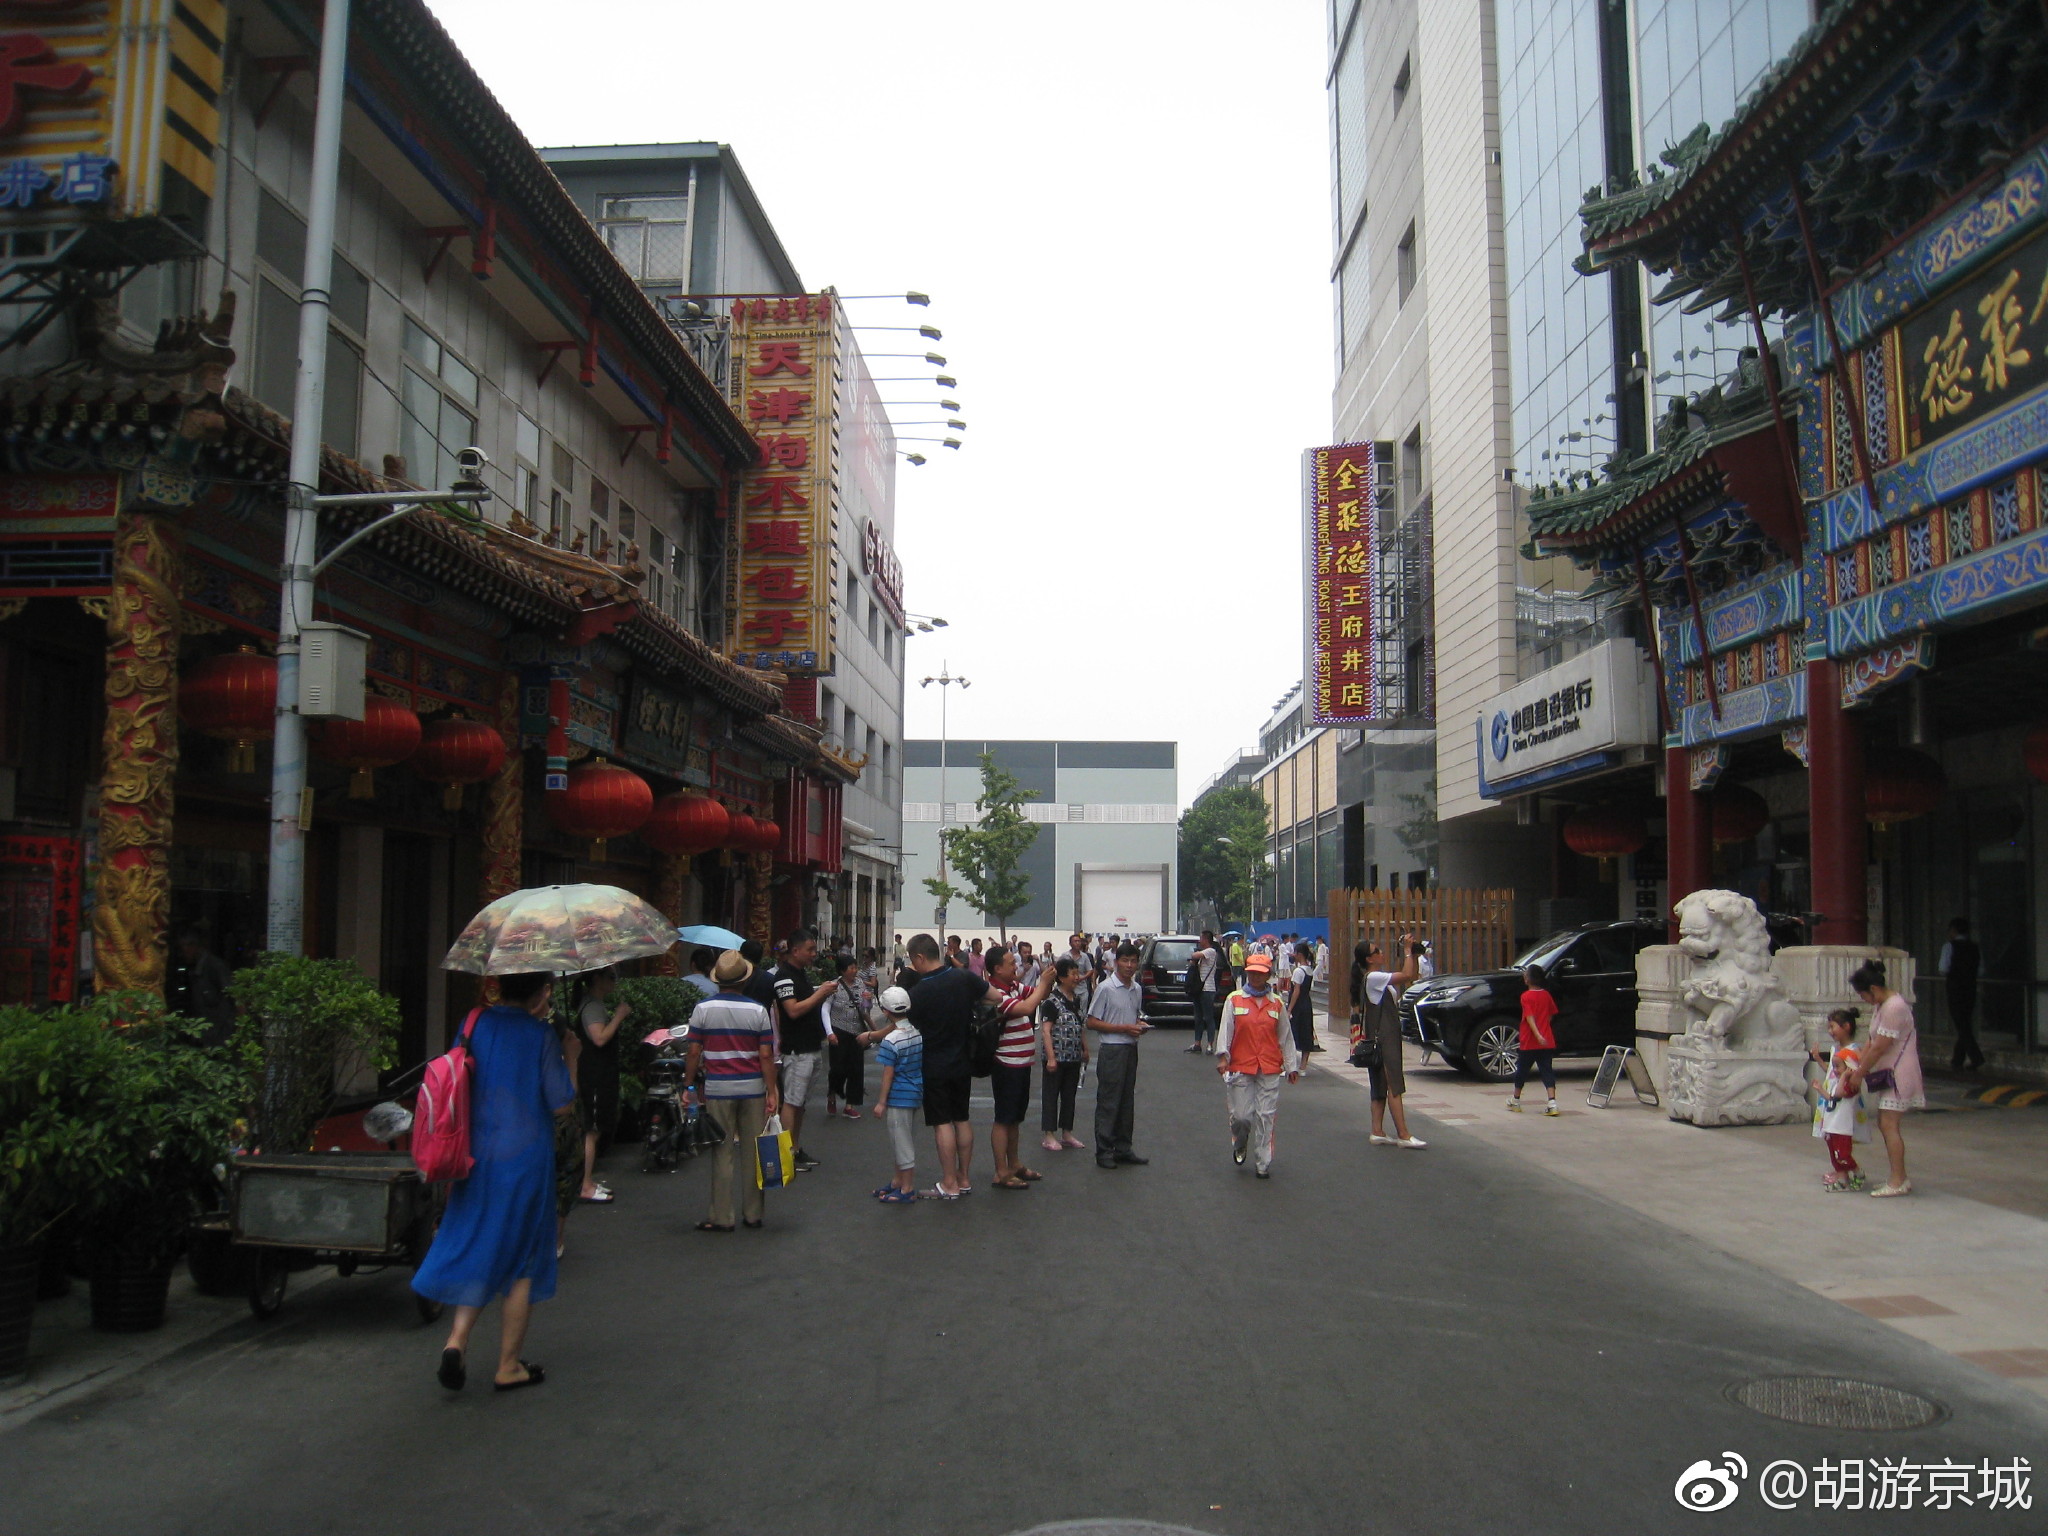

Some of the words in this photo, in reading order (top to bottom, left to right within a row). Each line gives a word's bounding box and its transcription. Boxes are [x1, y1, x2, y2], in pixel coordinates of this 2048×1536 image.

[731, 333, 751, 341] China
[756, 331, 806, 339] Time-honored
[809, 329, 831, 337] Brand
[743, 342, 812, 646] 天津狗不理包子
[1316, 450, 1329, 505] QUANJUDE
[729, 480, 740, 542] Steamed
[1317, 507, 1330, 574] WANGFUJING
[727, 547, 738, 602] Stuffed
[1318, 579, 1331, 614] ROAST
[1332, 458, 1366, 707] 全聚德王府井店
[726, 608, 737, 635] Bun
[1319, 619, 1331, 647] DUCK
[1318, 651, 1331, 717] RESTAURANT
[1511, 678, 1592, 736] 中国建设银行
[1513, 736, 1528, 753] China
[1528, 724, 1563, 747] Construction
[1563, 715, 1581, 735] Bank
